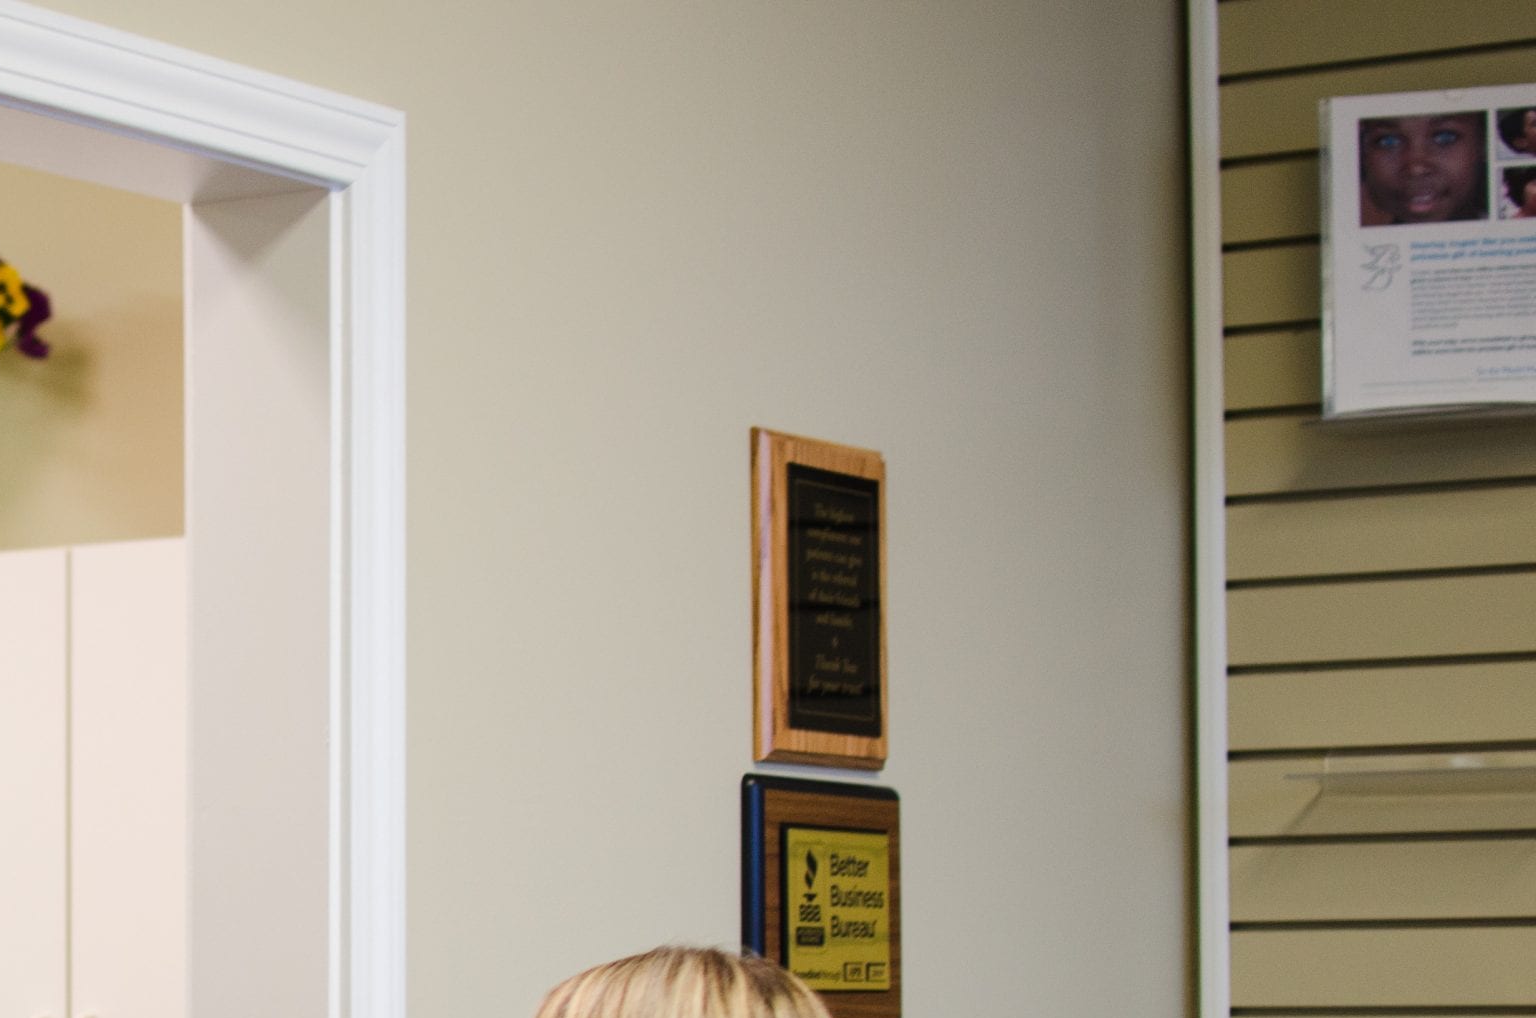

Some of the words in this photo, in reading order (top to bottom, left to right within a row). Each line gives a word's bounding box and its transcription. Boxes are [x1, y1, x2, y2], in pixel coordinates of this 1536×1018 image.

[830, 852, 870, 878] Better
[830, 884, 884, 909] Business
[798, 903, 822, 923] BBB
[831, 914, 876, 938] Bureau
